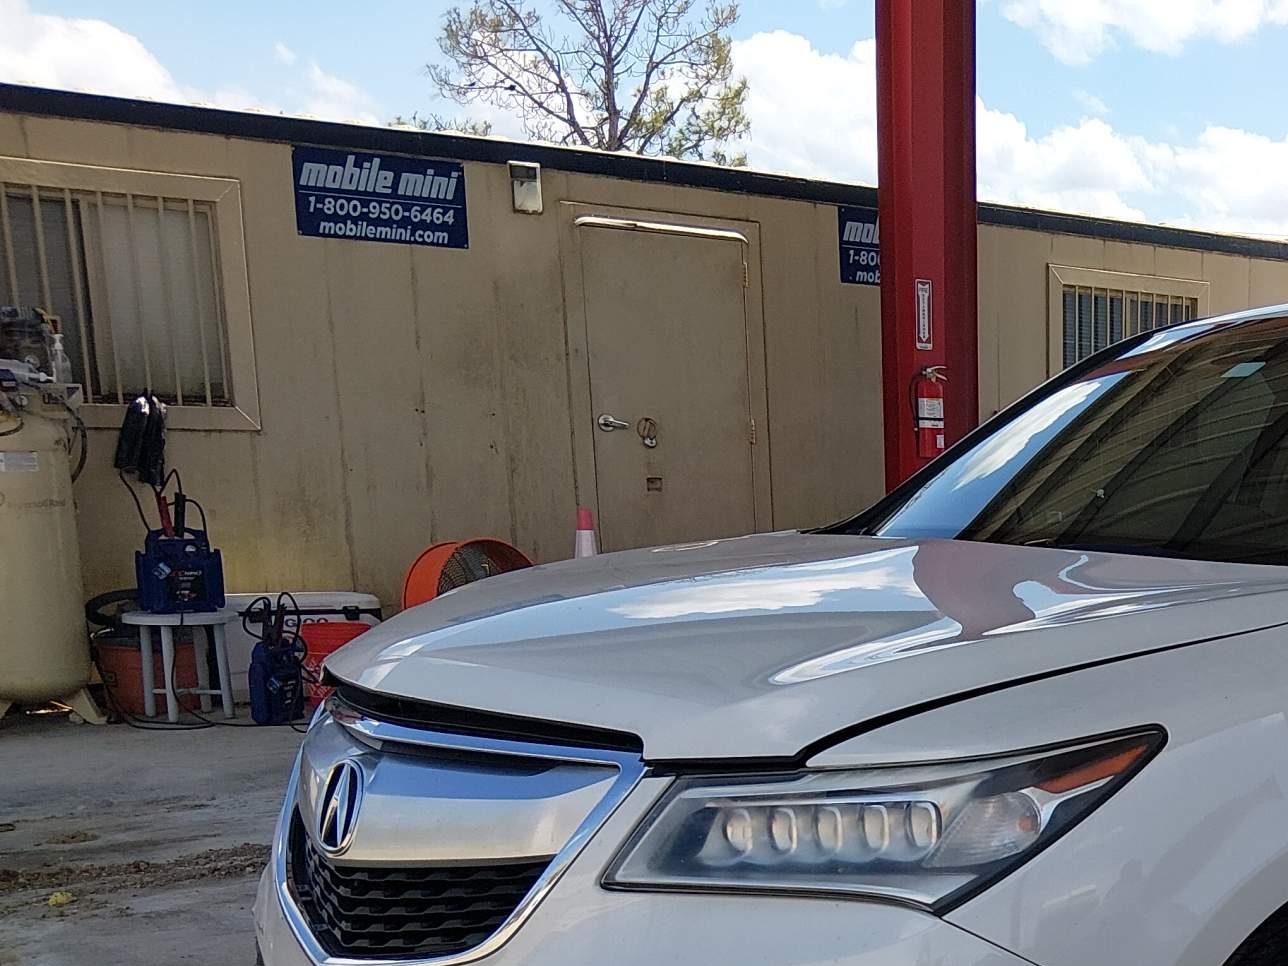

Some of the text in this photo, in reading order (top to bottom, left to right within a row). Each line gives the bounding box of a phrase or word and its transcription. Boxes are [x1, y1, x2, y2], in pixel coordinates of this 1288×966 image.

[299, 155, 458, 200] mobile mini
[308, 195, 455, 225] 1-800-950-6464
[319, 220, 449, 244] mobilemini.com
